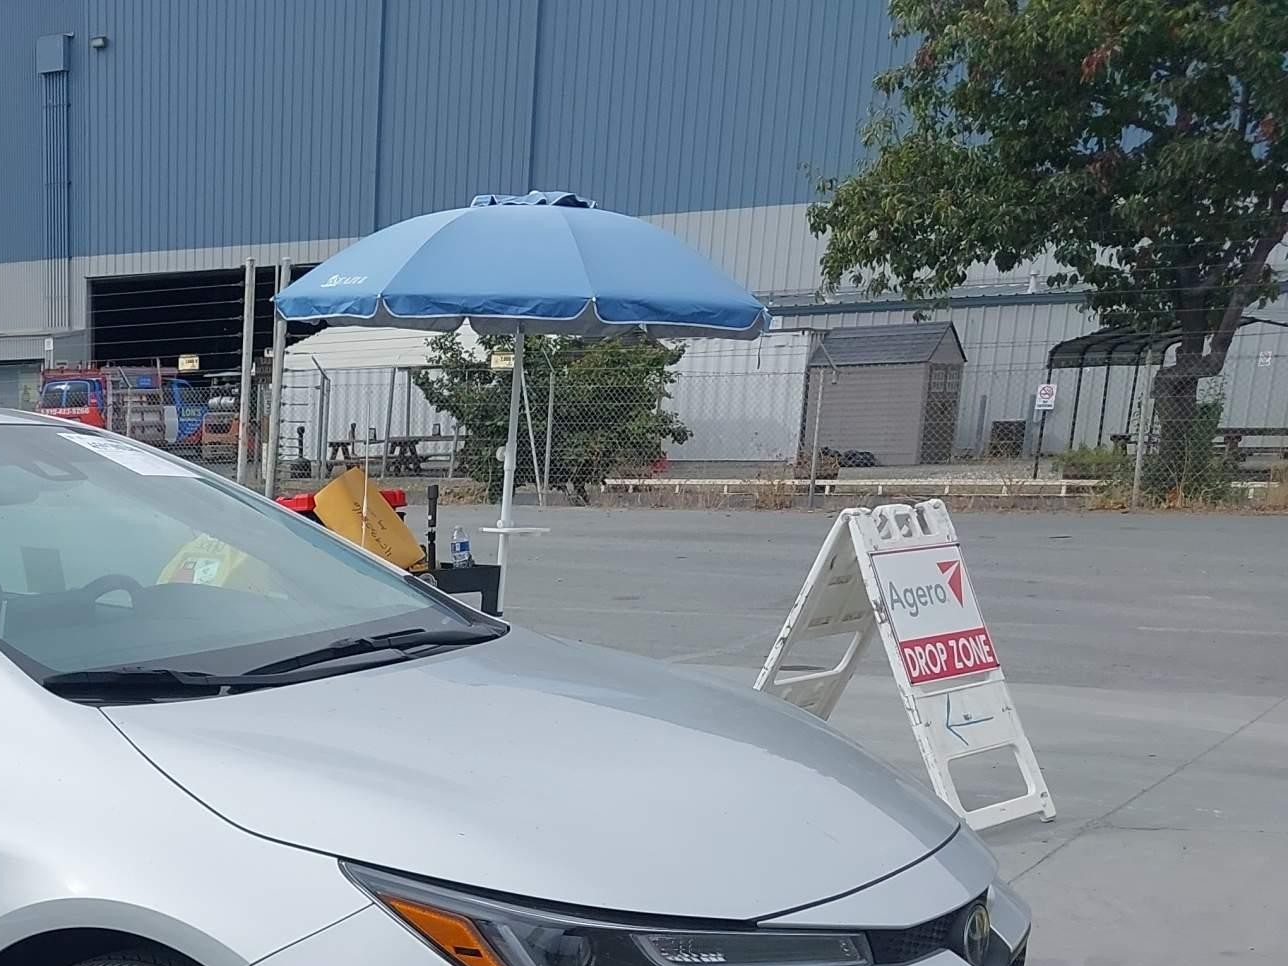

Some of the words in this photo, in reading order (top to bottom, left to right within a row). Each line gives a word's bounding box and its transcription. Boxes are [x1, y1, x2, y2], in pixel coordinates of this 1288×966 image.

[889, 581, 948, 618] Agero
[903, 642, 948, 678] DROP
[948, 634, 995, 670] ZONE
